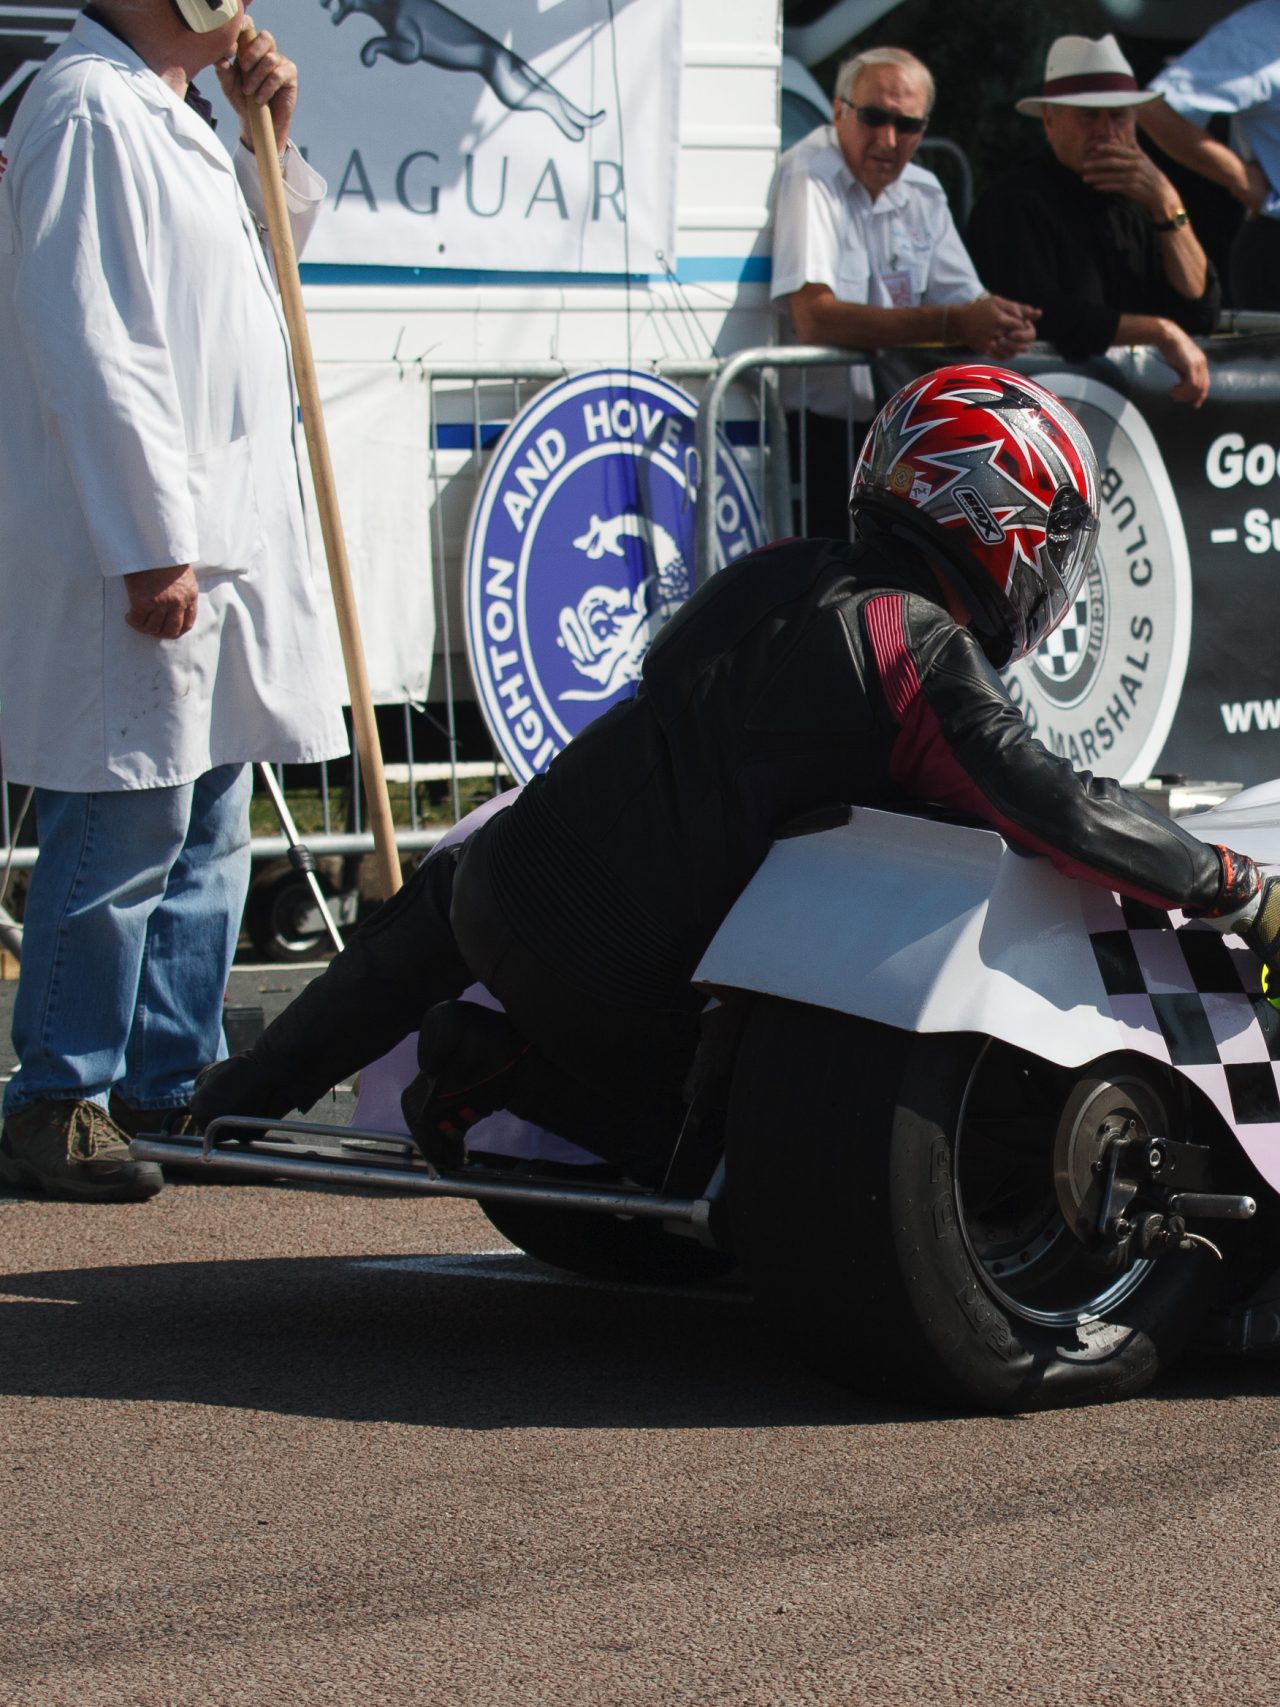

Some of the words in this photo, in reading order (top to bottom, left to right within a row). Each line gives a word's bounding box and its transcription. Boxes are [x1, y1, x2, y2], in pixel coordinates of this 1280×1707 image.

[300, 147, 628, 222] AGUAR
[503, 427, 566, 533] AND
[583, 399, 683, 459] HOVE
[1100, 467, 1153, 588] CLUB
[486, 556, 560, 773] IGHTON
